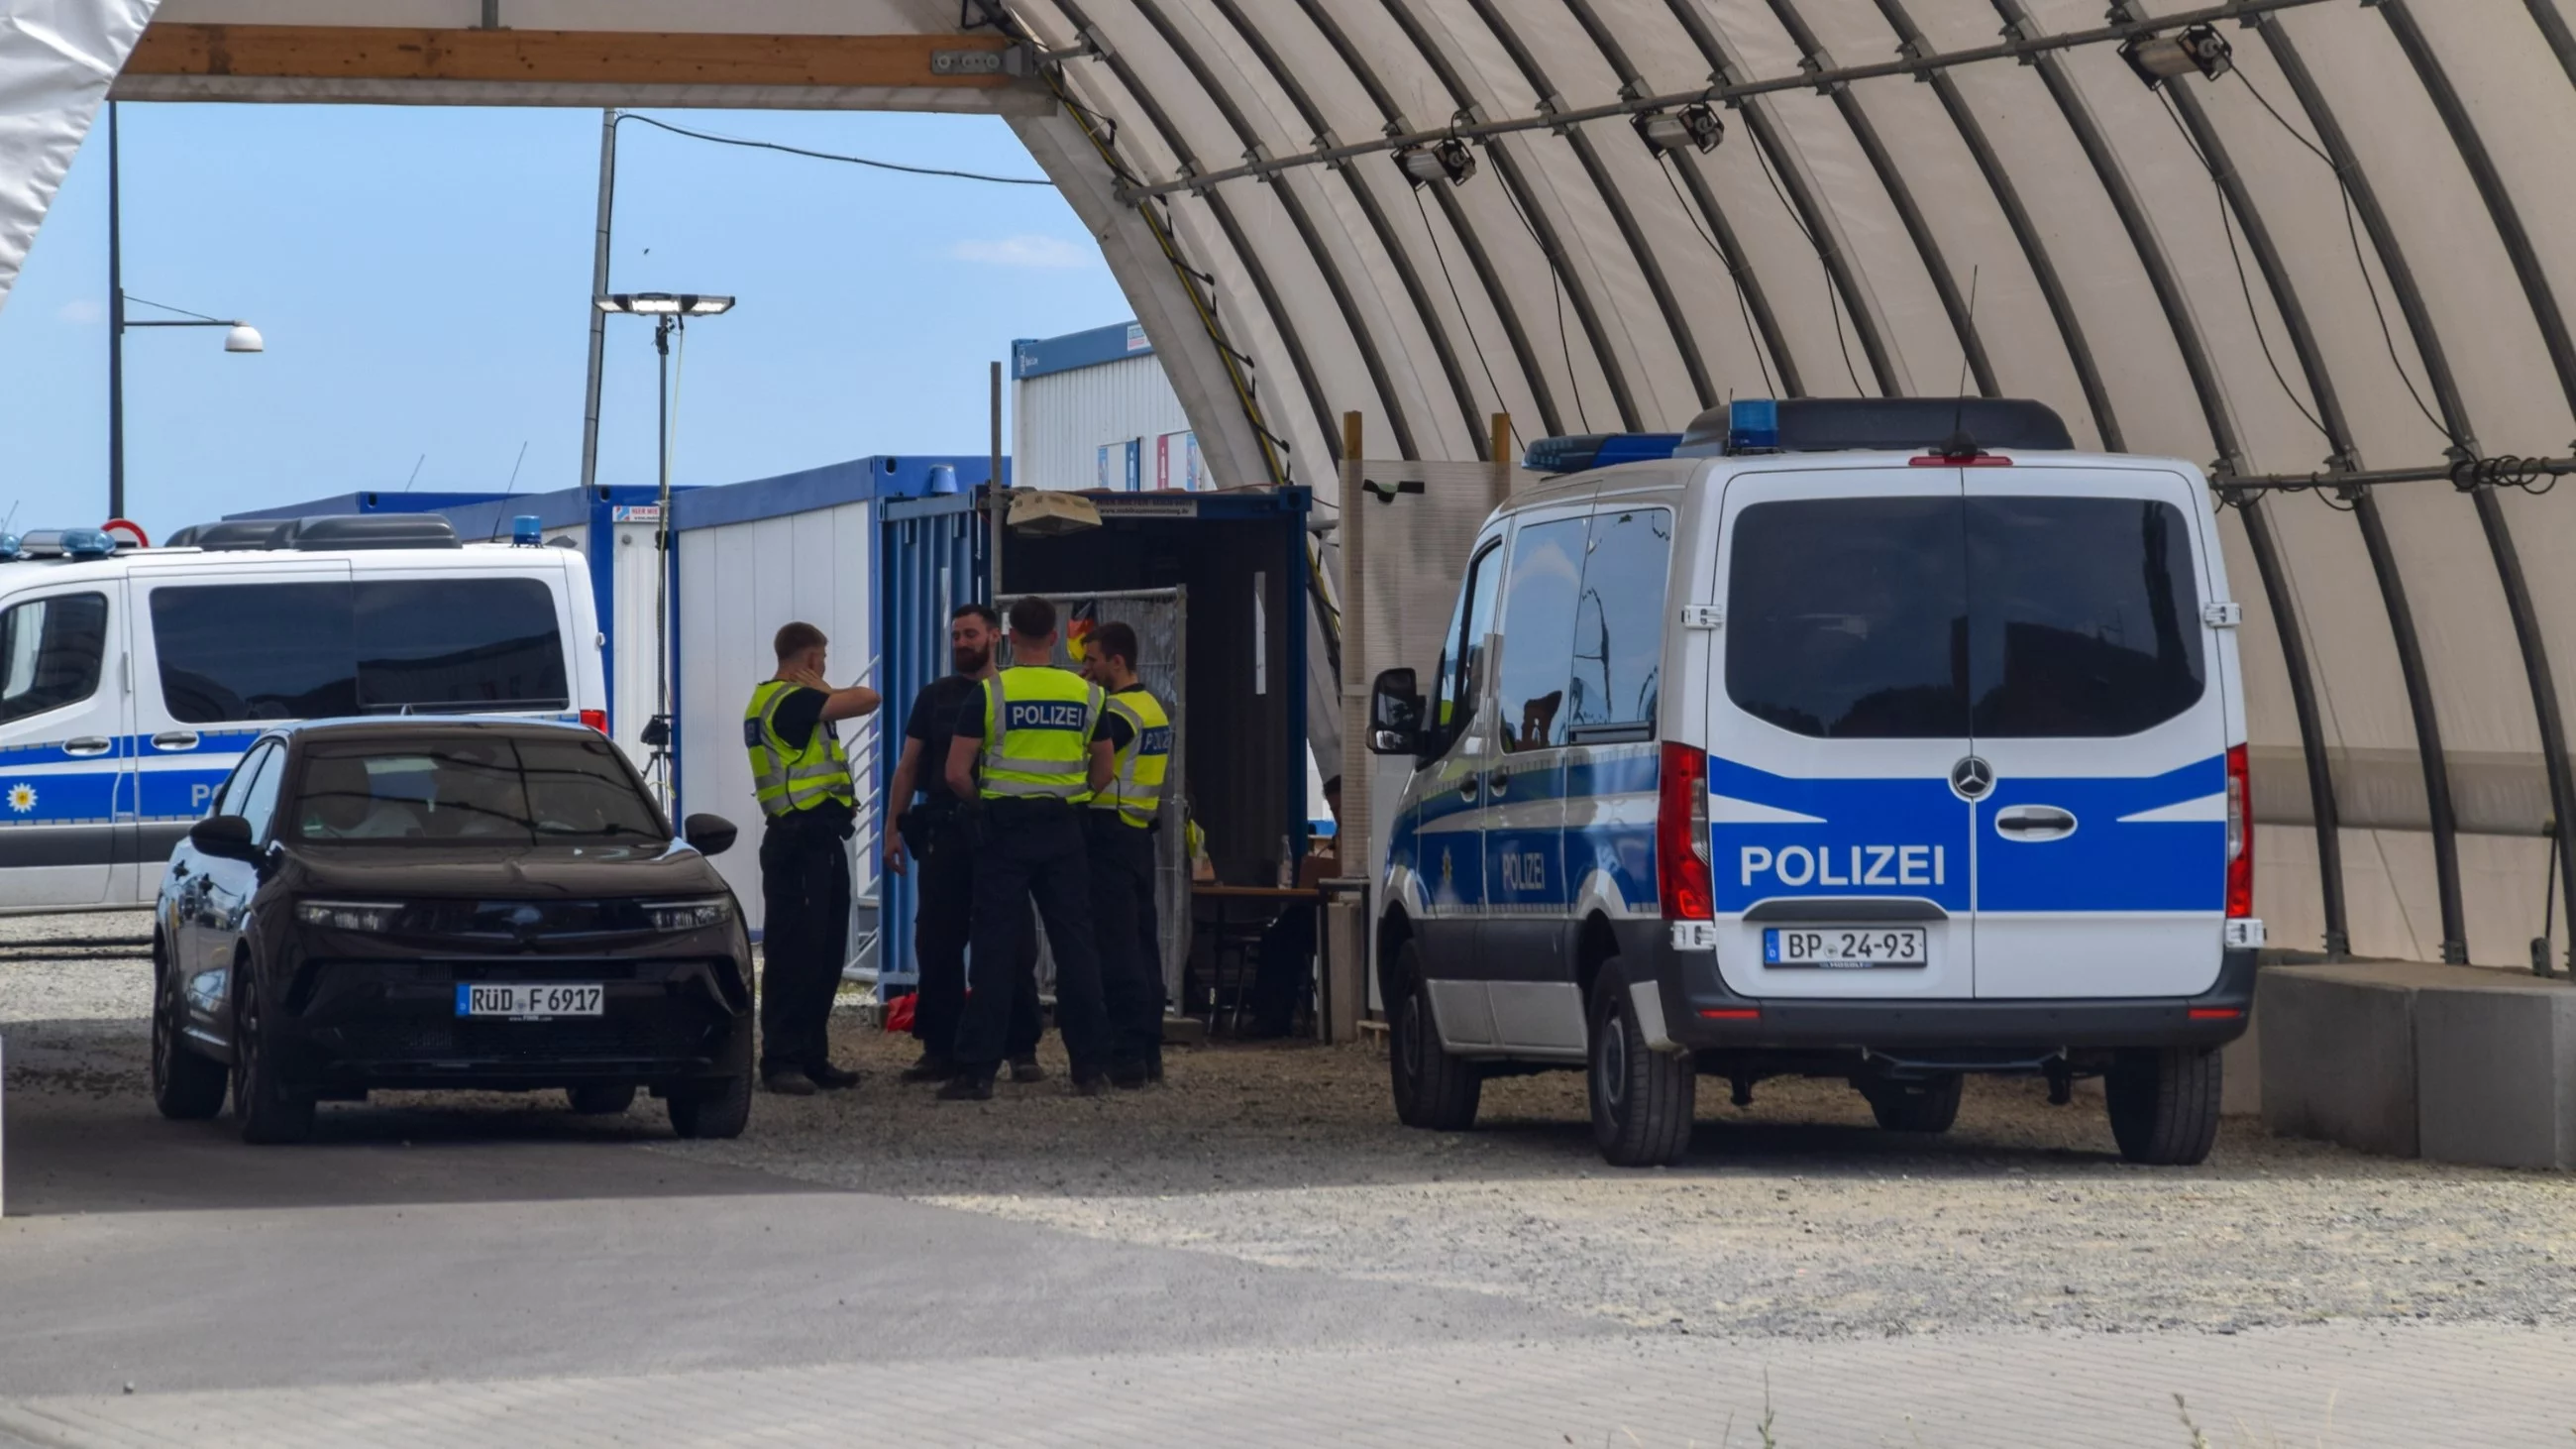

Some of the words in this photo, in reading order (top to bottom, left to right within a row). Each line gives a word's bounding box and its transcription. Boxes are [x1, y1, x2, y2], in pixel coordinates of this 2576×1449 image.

[1012, 705, 1083, 726] POLIZEI
[1502, 852, 1546, 890] POLIZEI
[1741, 845, 1945, 887] POLIZEI
[1788, 934, 1822, 958] BP
[1841, 934, 1915, 958] 24-93
[472, 988, 513, 1011] RÜD
[530, 988, 543, 1011] F
[548, 988, 600, 1011] 6917
